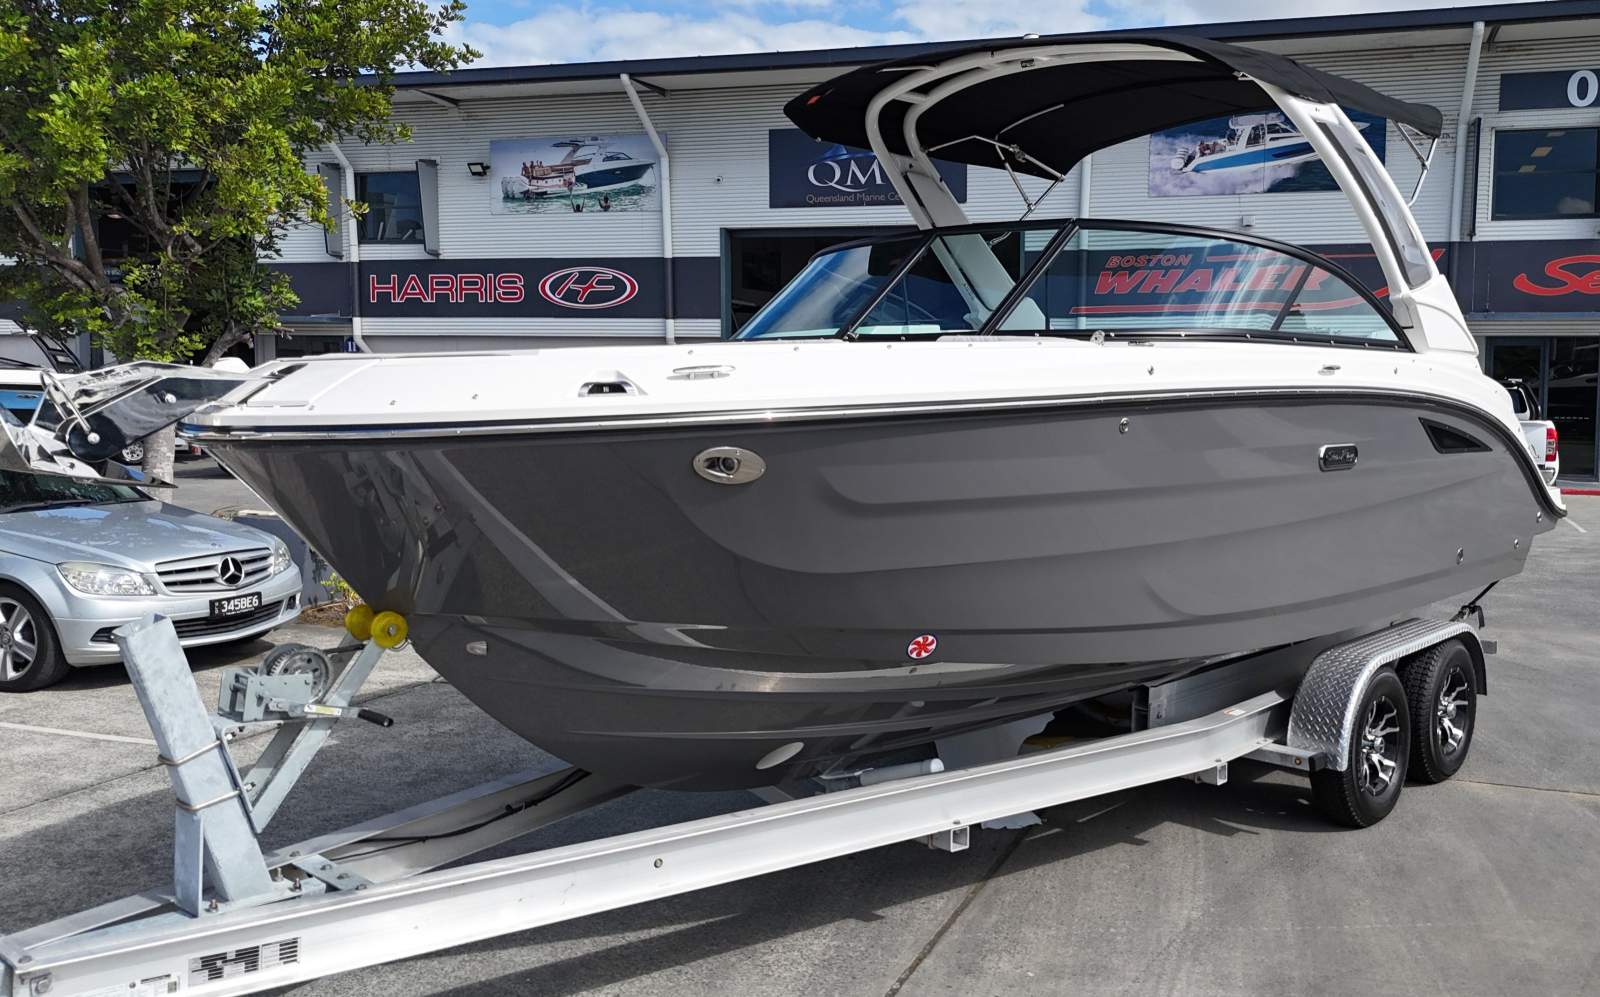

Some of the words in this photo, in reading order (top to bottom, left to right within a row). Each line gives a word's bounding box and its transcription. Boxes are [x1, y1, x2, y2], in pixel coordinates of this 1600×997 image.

[807, 158, 887, 193] QM
[806, 193, 855, 205] Queensland
[856, 192, 886, 202] Marine
[1105, 254, 1193, 268] BOSTON
[369, 273, 525, 303] HARRIS
[1094, 265, 1331, 295] WHALER
[221, 594, 259, 613] 345BE6
